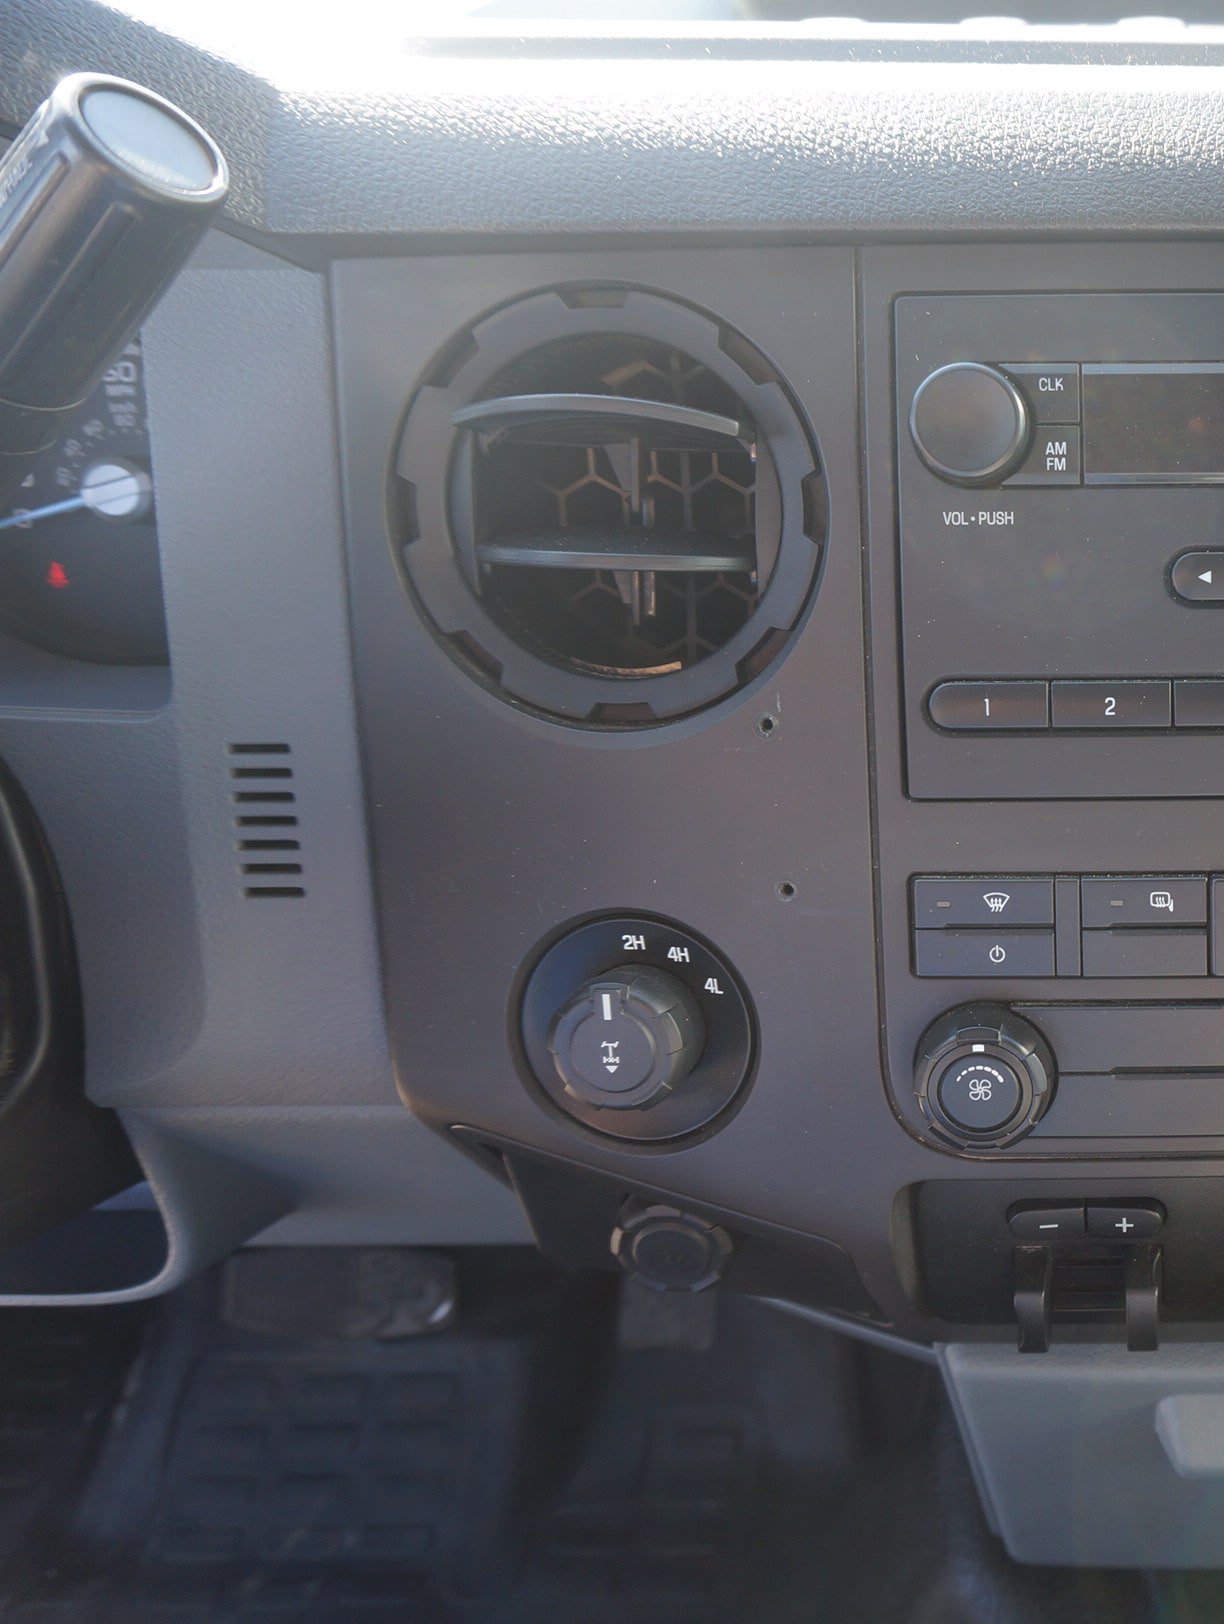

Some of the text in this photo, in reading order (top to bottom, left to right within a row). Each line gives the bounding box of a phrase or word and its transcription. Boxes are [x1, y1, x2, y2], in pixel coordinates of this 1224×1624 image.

[1038, 377, 1064, 392] CLK
[1045, 441, 1067, 456] AM
[1046, 457, 1066, 471] FM
[984, 698, 990, 717] 1
[1104, 696, 1116, 716] 2
[621, 934, 646, 950] 2H
[667, 946, 690, 963] 4H
[704, 977, 724, 995] 4L
